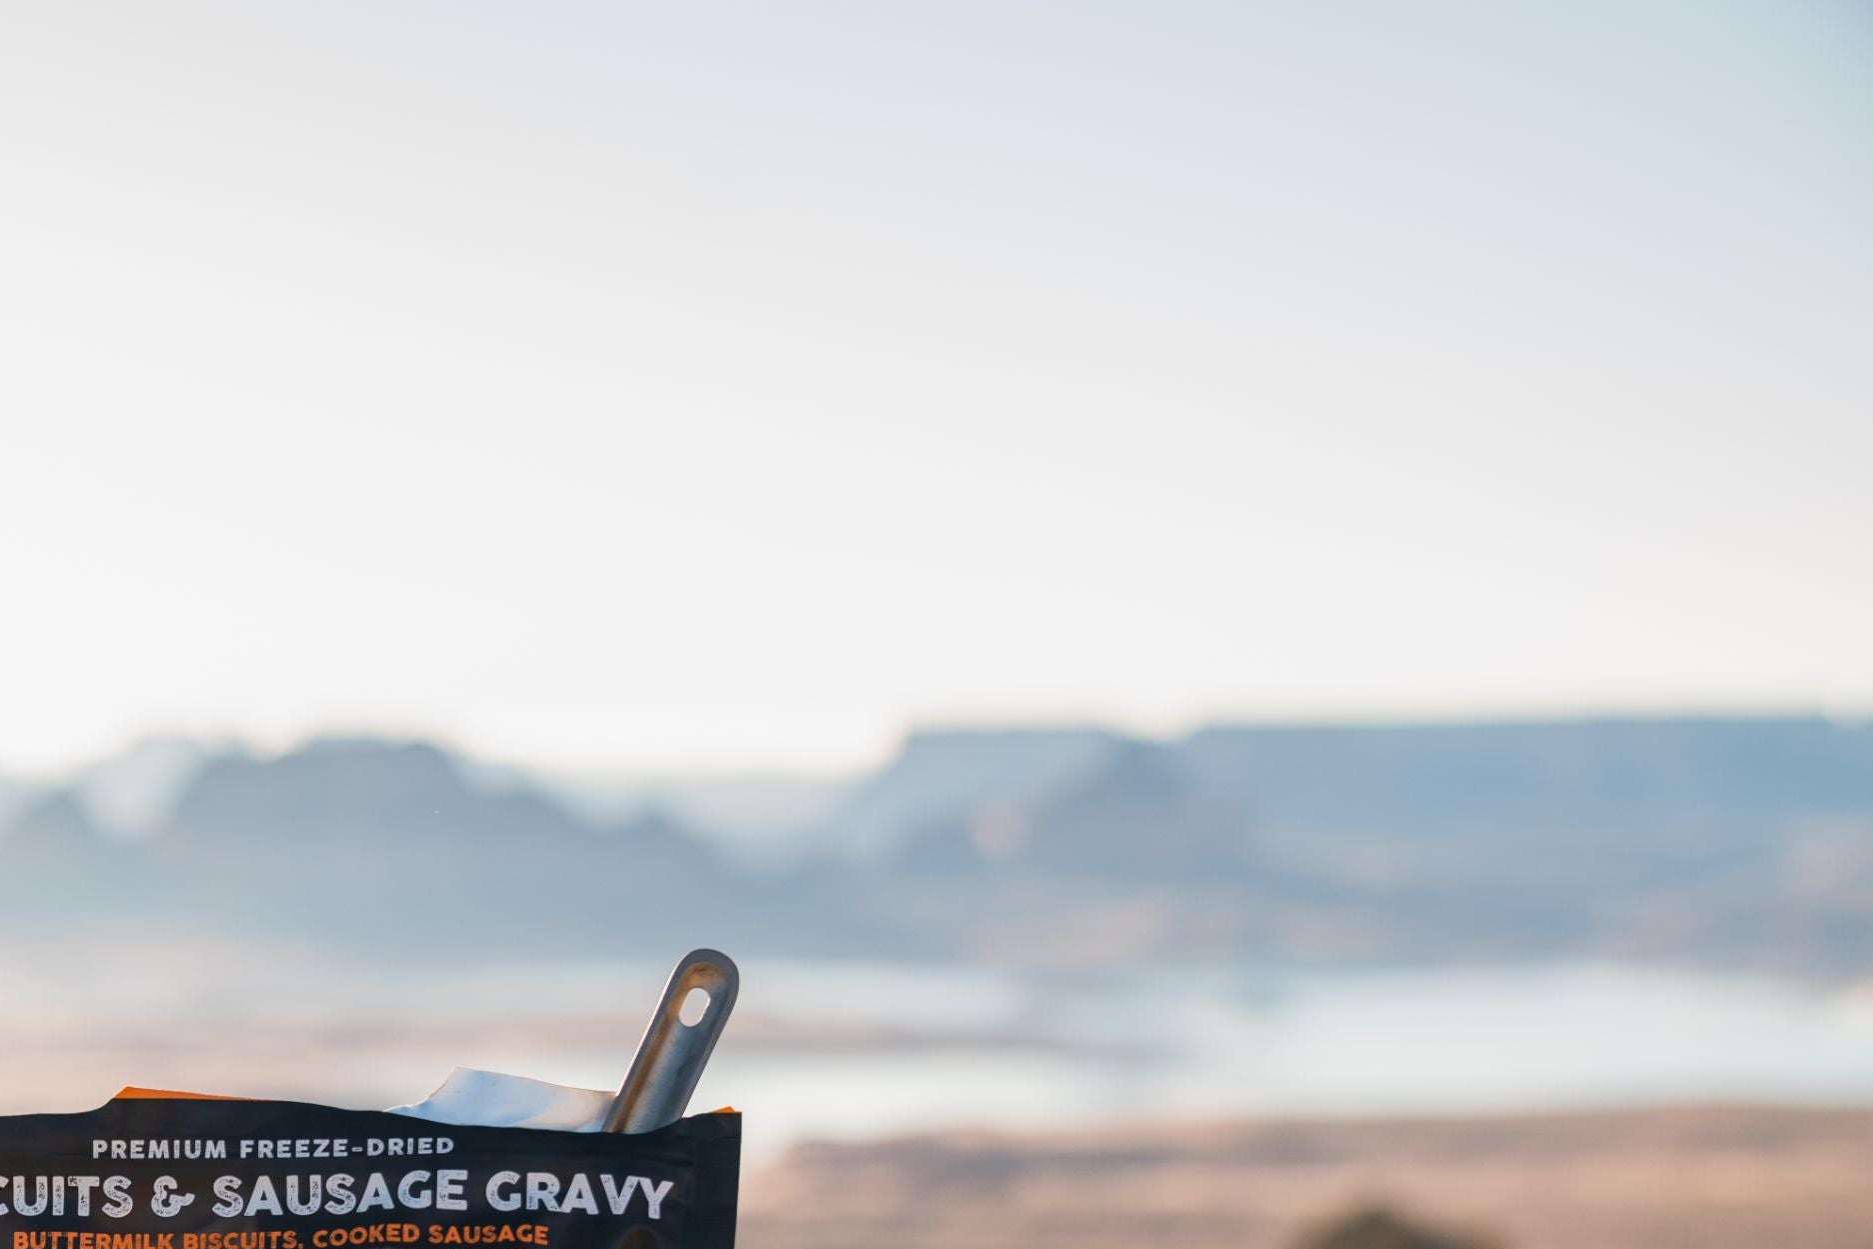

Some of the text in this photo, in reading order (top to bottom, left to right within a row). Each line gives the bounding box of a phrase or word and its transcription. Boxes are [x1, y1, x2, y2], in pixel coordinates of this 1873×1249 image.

[92, 1137, 454, 1160] PREMIUM FREEZE-DRIED
[150, 1175, 195, 1218] &
[211, 1169, 469, 1218] SAUSAGE
[485, 1170, 674, 1220] GRAVY
[312, 1223, 420, 1248] COOKED
[428, 1223, 549, 1246] SAUSAGE
